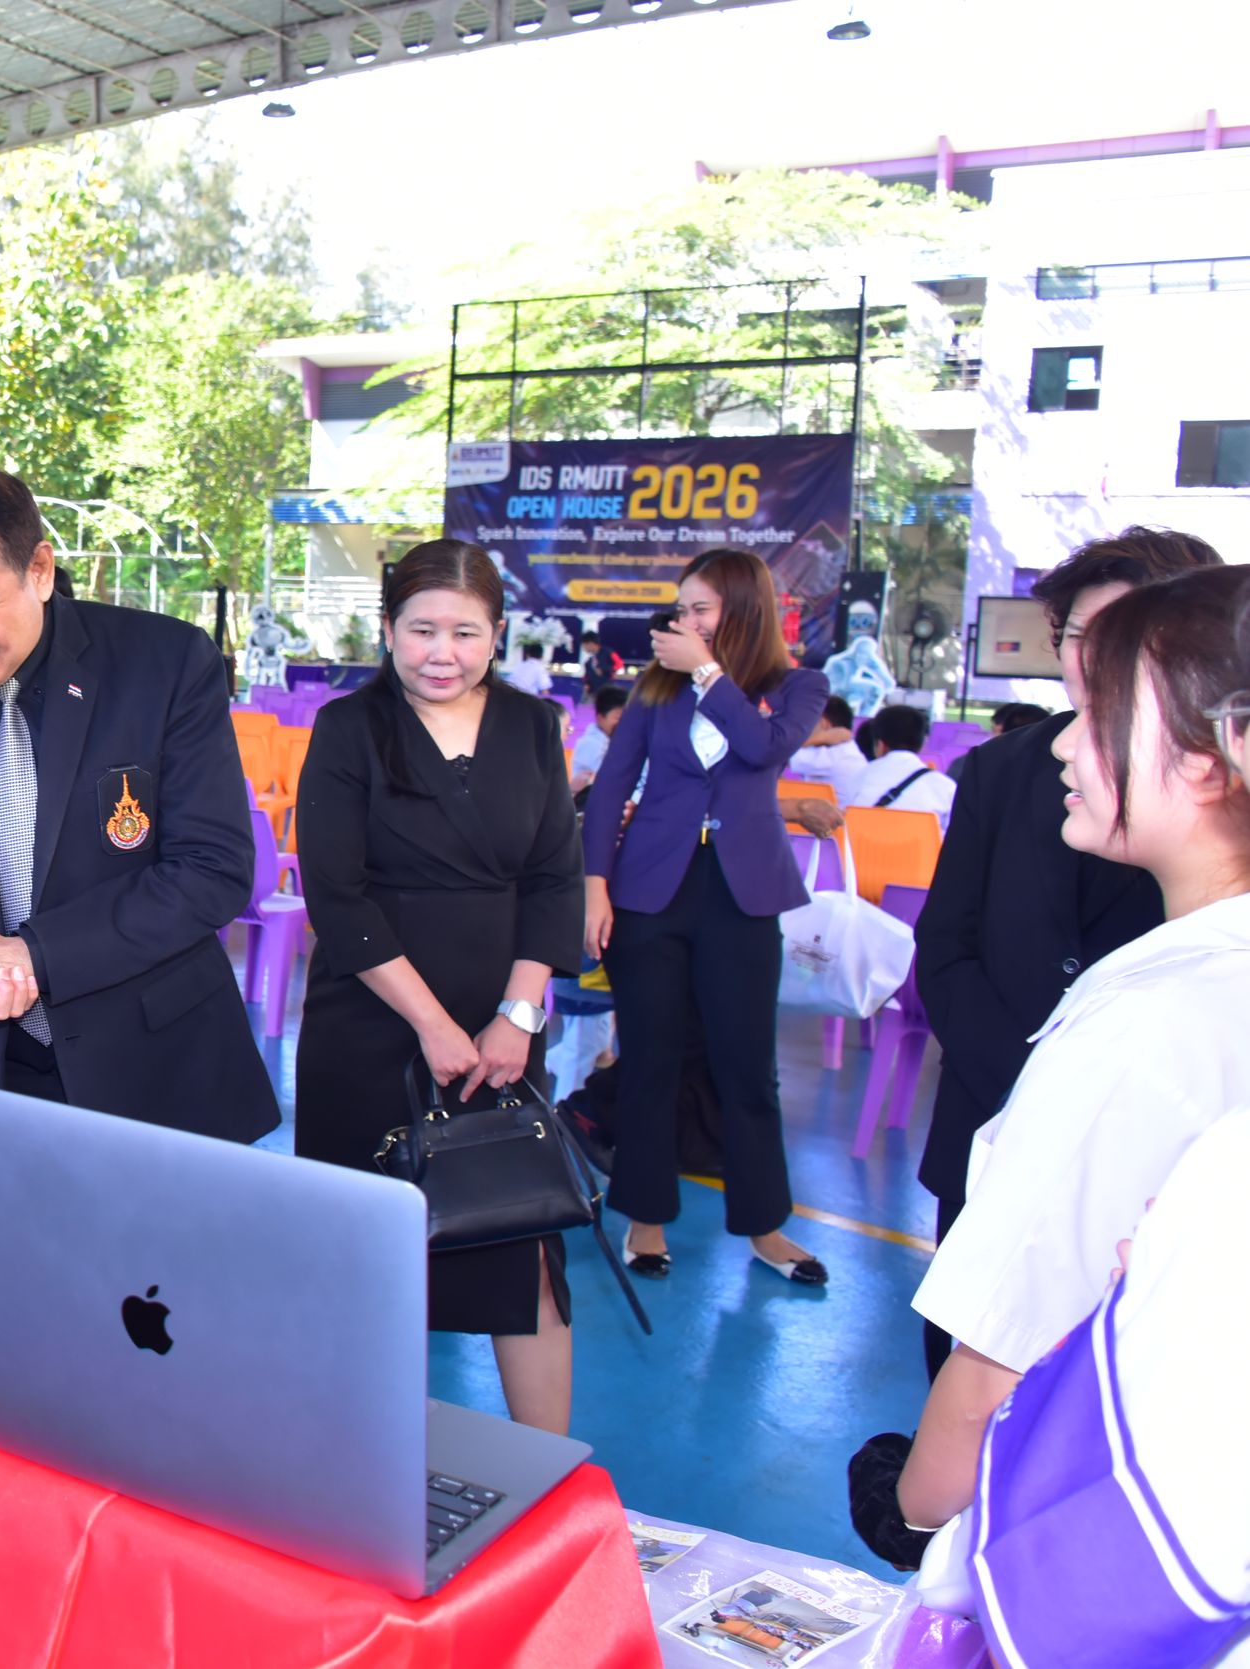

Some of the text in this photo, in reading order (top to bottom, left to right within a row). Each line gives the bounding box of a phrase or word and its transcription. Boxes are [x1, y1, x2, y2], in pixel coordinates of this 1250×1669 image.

[518, 465, 628, 490] IDS RMUTT
[628, 463, 761, 519] 2026
[506, 495, 624, 519] OPEN HOUSE
[477, 525, 796, 546] Spark Innovation, Explore Our Dream Together
